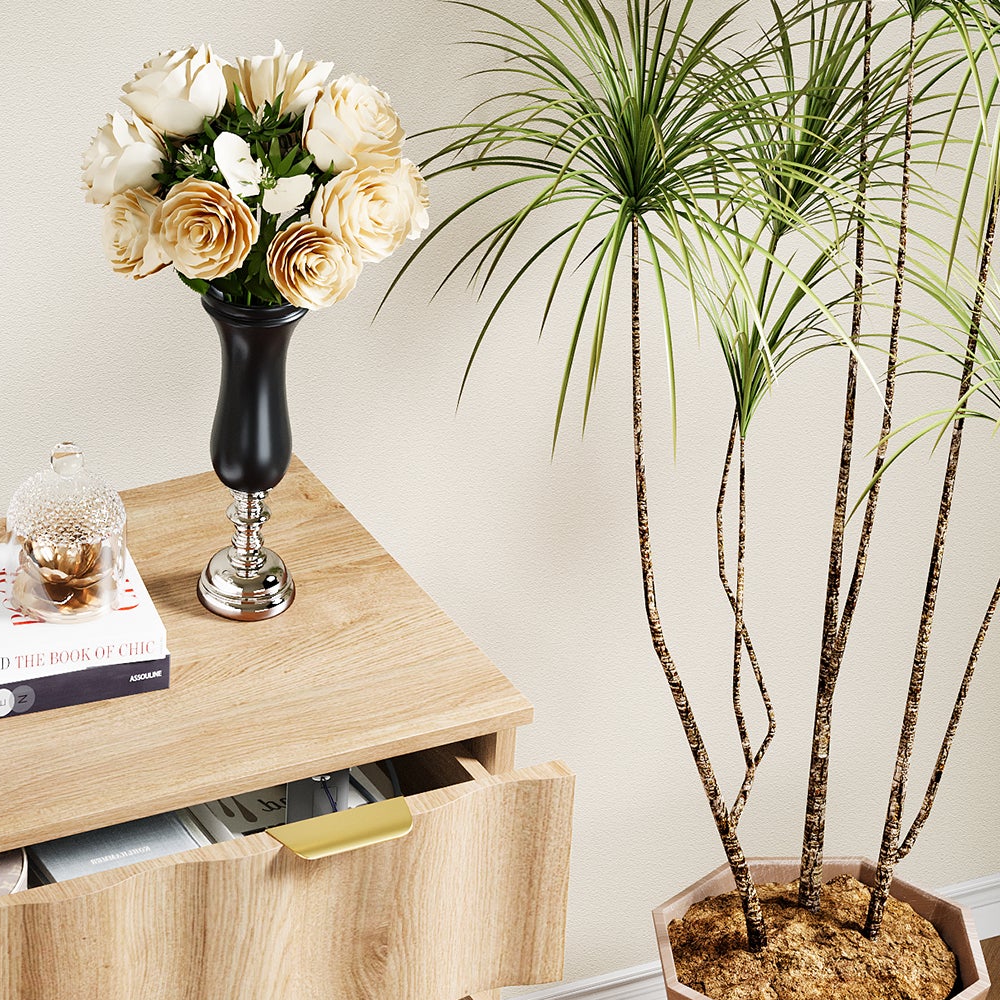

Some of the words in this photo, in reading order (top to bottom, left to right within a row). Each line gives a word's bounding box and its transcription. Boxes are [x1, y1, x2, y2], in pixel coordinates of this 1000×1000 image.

[14, 653, 45, 670] THE
[50, 647, 91, 665] BOOK
[95, 644, 115, 660] OF
[118, 640, 156, 656] CHIC
[129, 669, 163, 683] ASSOULINE
